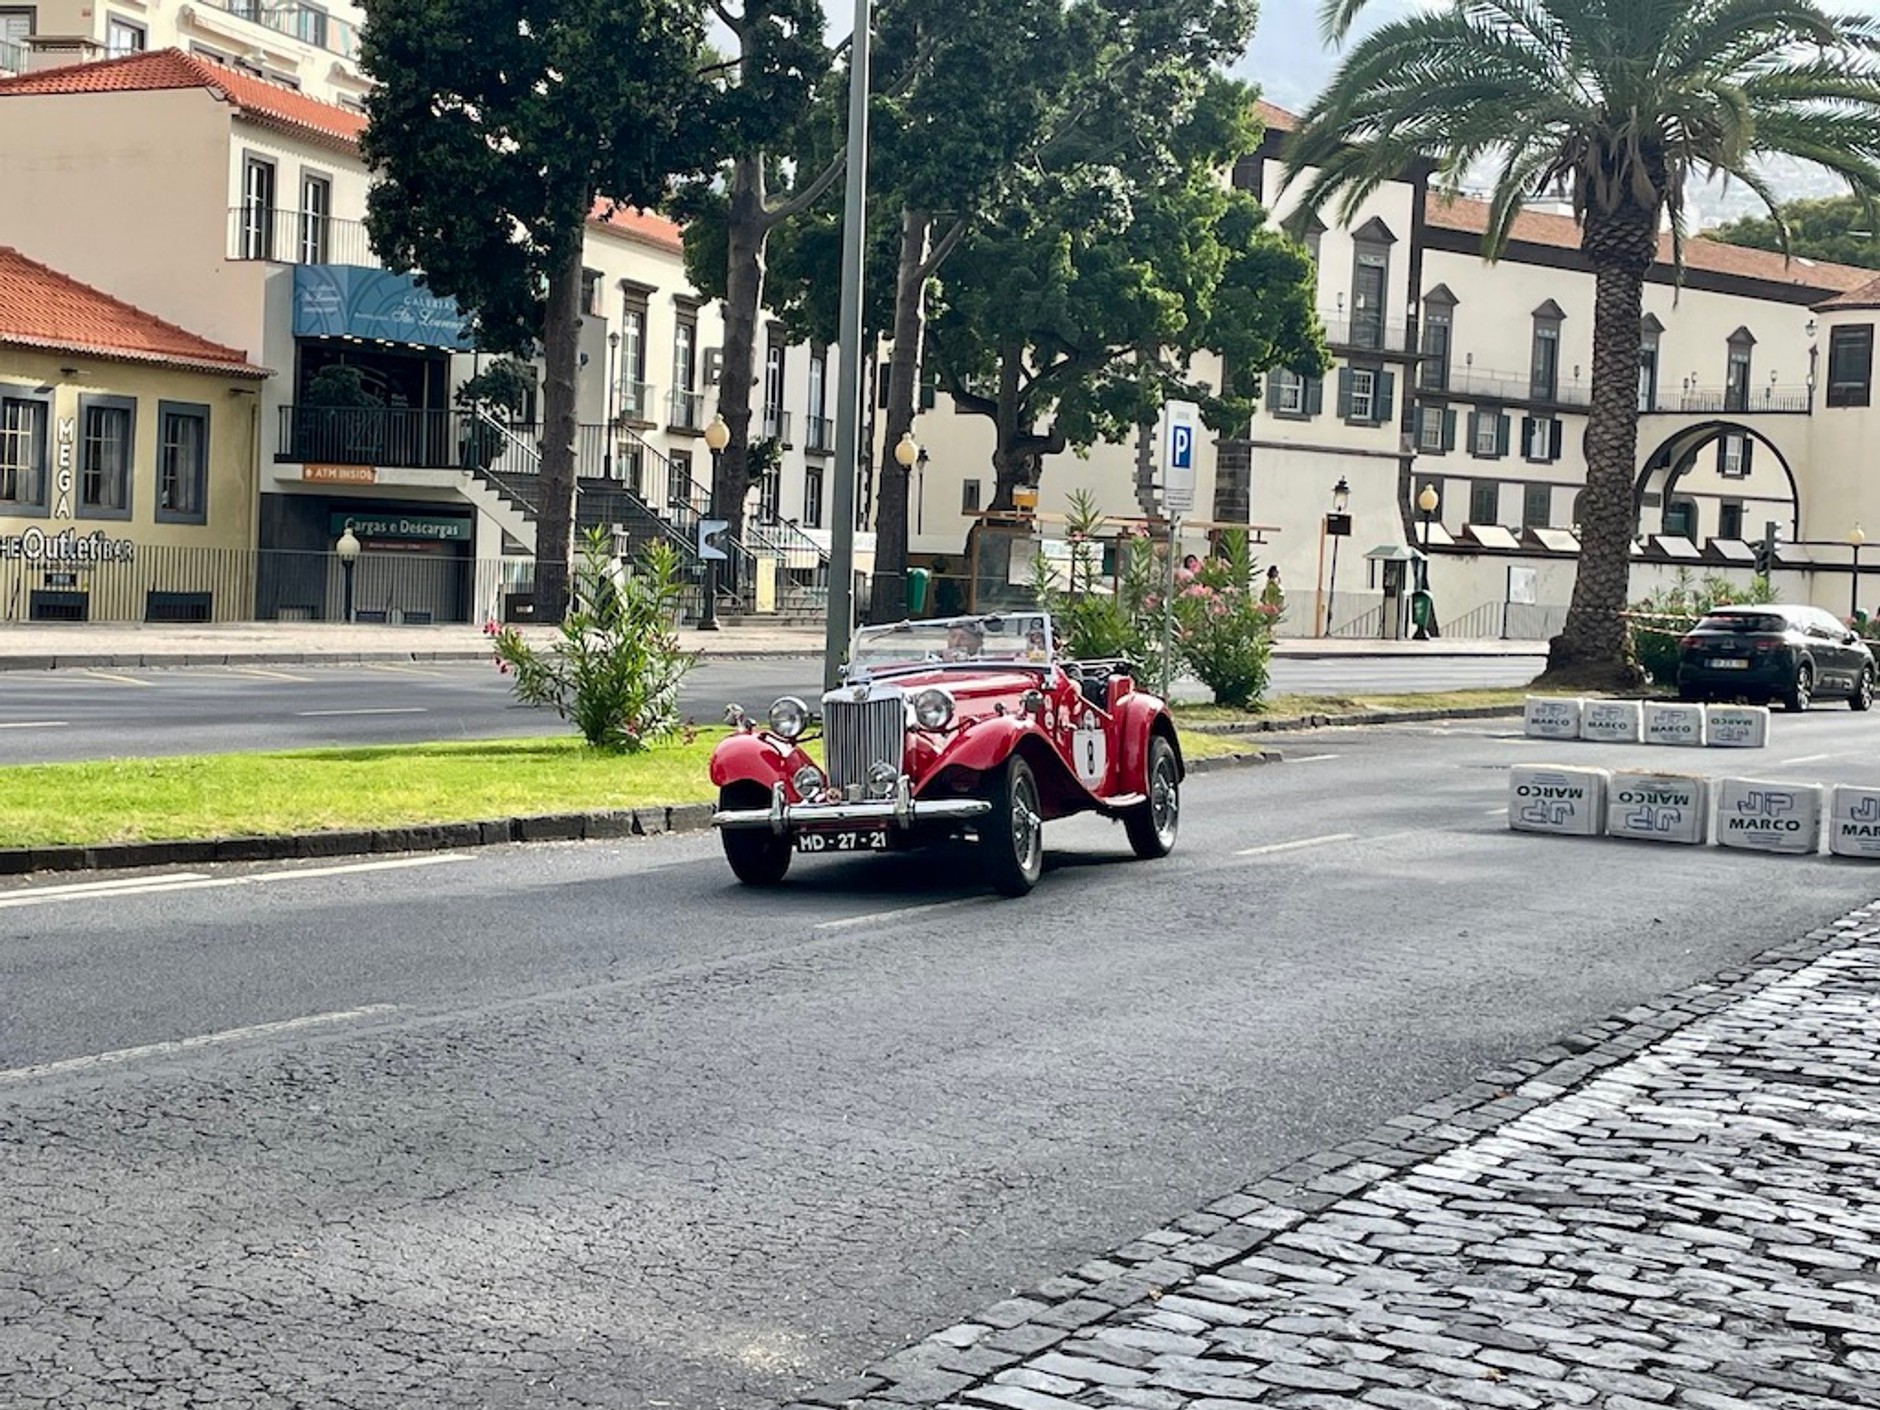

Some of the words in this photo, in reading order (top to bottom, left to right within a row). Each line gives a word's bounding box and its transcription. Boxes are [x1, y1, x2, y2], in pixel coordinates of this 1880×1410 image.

[1175, 428, 1189, 466] P
[55, 417, 74, 519] MEGA
[315, 468, 337, 478] ATM
[345, 517, 387, 535] Cargas
[389, 522, 398, 533] e
[400, 520, 458, 539] Descargas
[22, 526, 98, 560] Outlet
[101, 538, 134, 562] BAR
[1531, 718, 1570, 727] MARCO
[1588, 721, 1627, 730] MARCO
[1711, 718, 1753, 726] MARCO
[1651, 725, 1691, 734] MARCO
[1087, 740, 1095, 775] 8
[1517, 785, 1583, 799] MARCO
[1619, 791, 1689, 806] MARCO
[1729, 818, 1801, 831] MARCO
